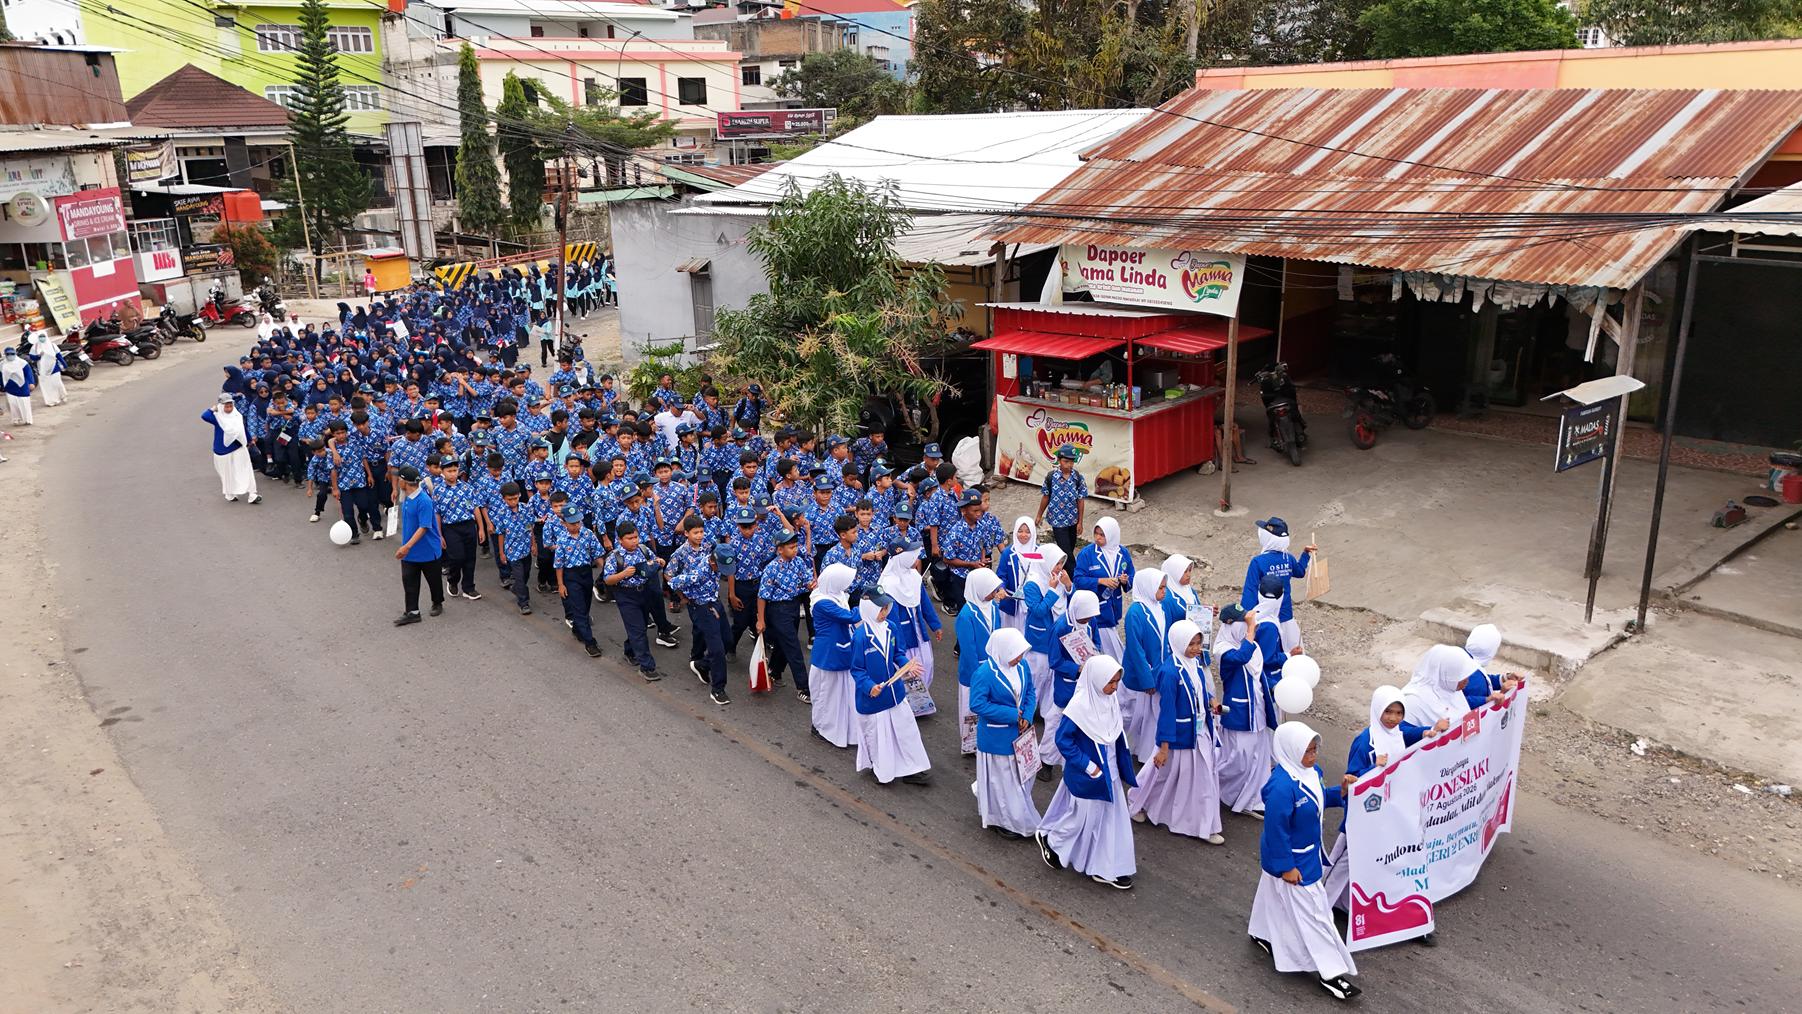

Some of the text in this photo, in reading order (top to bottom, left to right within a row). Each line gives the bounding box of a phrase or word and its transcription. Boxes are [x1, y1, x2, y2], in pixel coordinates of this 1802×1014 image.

[70, 204, 114, 218] MANDAYOUNG
[1087, 244, 1146, 266] Dapoer
[1078, 265, 1115, 281] ama
[1120, 265, 1167, 289] Linda
[1580, 420, 1600, 434] MADAS
[1421, 757, 1489, 808] DONESIAKU
[1436, 793, 1463, 810] Agustus
[1376, 841, 1424, 865] “Indone
[1425, 809, 1458, 828] daulat,
[1396, 864, 1427, 879] “Mad
[1426, 839, 1444, 850] aju,
[1427, 846, 1450, 865] GERI
[1355, 914, 1365, 926] 81
